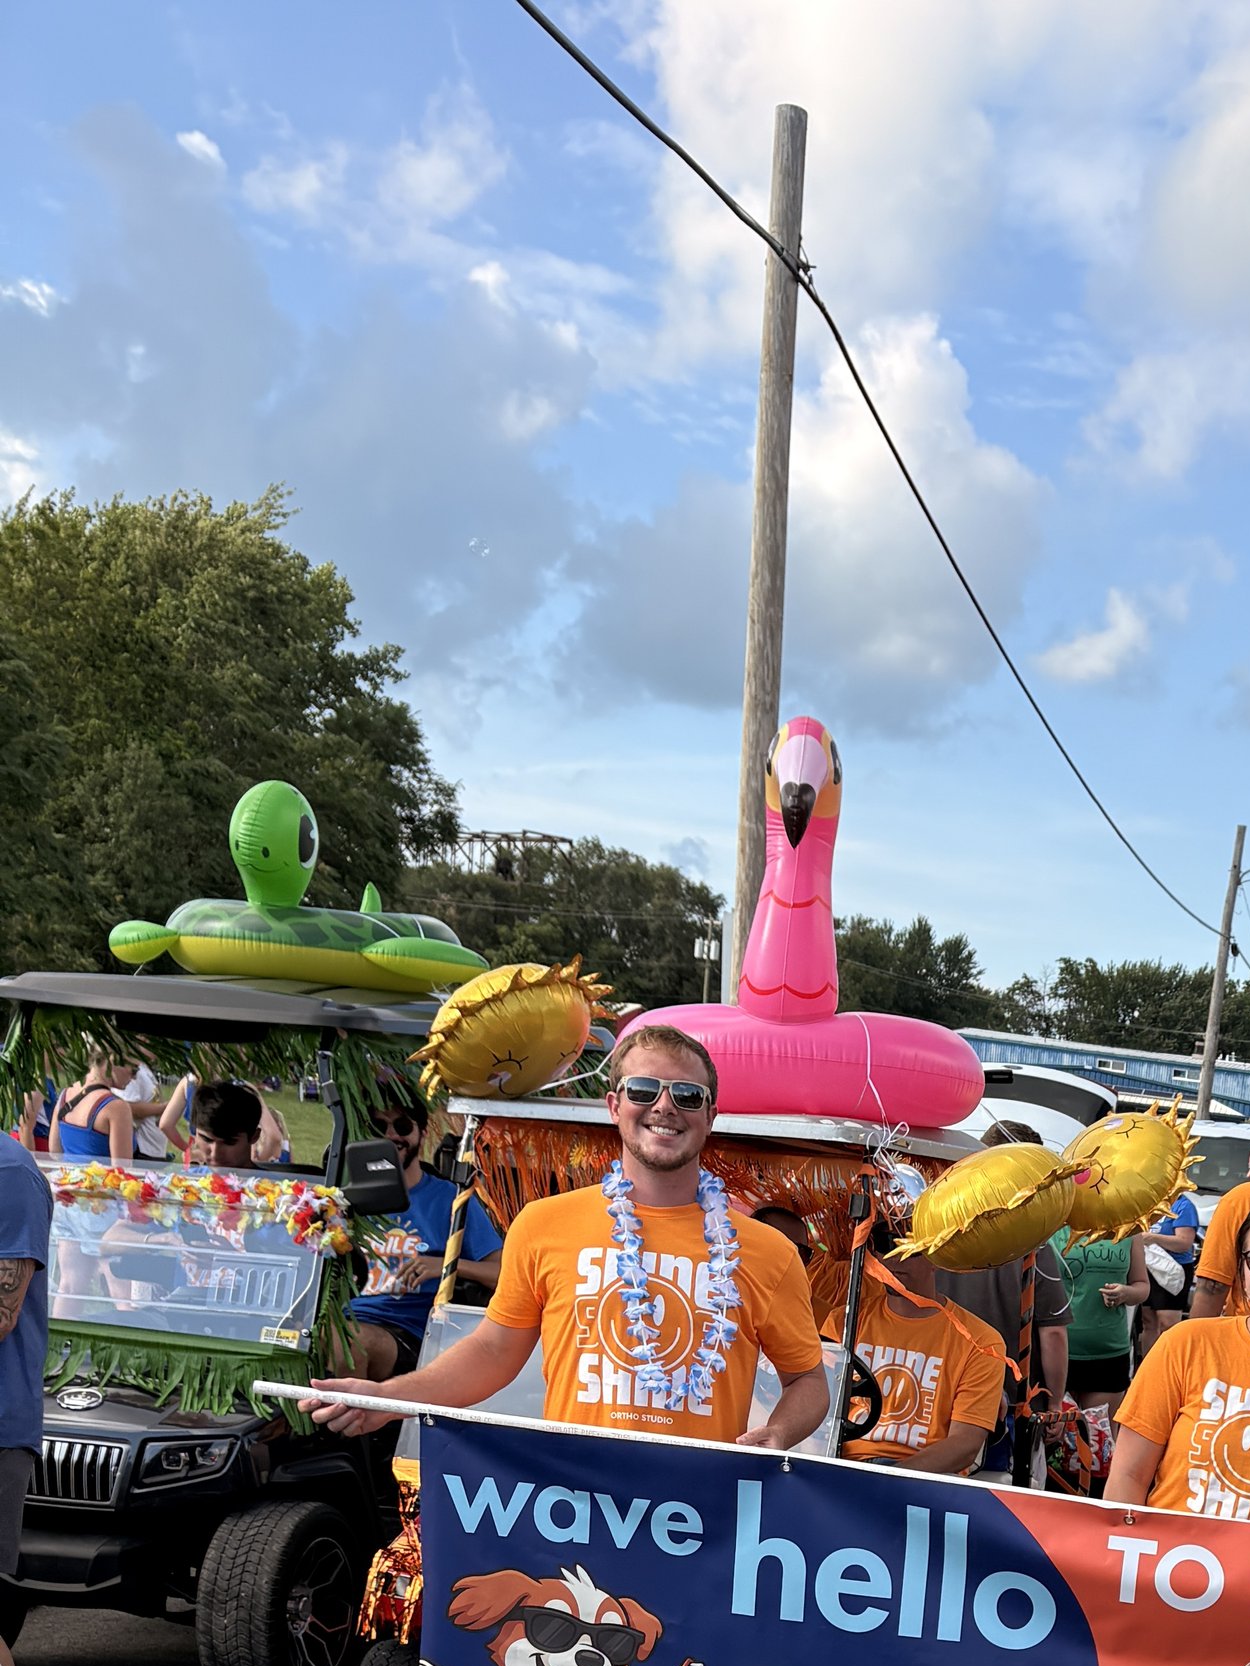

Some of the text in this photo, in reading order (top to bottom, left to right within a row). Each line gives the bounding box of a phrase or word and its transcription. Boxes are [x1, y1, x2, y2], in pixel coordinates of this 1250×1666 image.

[610, 1411, 674, 1425] ORTHO STUDIO
[442, 1473, 1057, 1650] wave hello
[1107, 1535, 1225, 1613] TO
